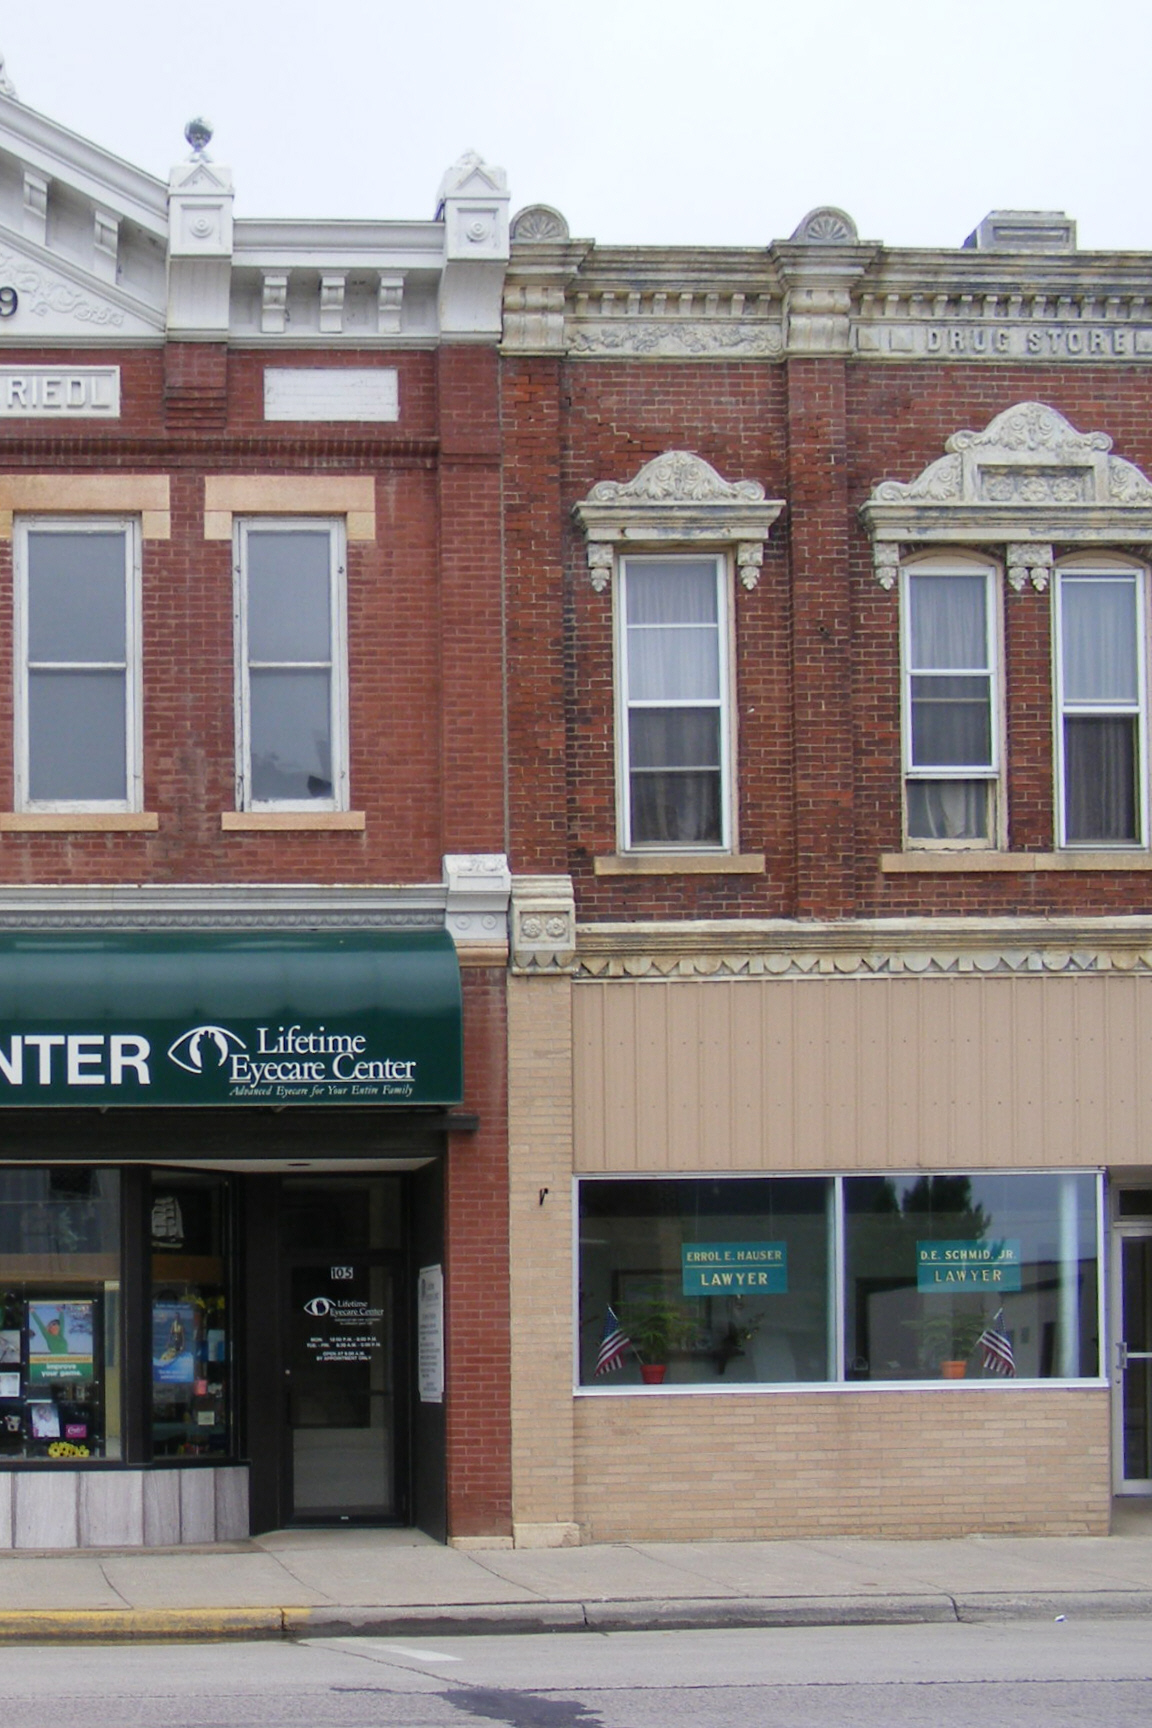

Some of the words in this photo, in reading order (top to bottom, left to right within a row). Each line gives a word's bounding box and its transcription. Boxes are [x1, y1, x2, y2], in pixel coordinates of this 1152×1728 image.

[927, 328, 1010, 353] DRUG
[1027, 328, 1126, 354] STORE
[7, 376, 110, 409] RIEDL
[257, 1026, 366, 1054] Lifetime
[230, 1054, 325, 1088] Eyecare
[332, 1053, 416, 1080] Center
[229, 1086, 273, 1096] Advanced
[276, 1086, 308, 1098] Eyecare
[309, 1085, 325, 1097] for
[328, 1085, 347, 1095] Your
[382, 1084, 413, 1097] Family
[686, 1251, 722, 1261] ERROL
[724, 1251, 735, 1260] E.
[737, 1250, 782, 1260] HAUSER
[332, 1267, 353, 1279] 105
[701, 1272, 768, 1286] LAWYER
[934, 1269, 1002, 1282] LAWYER
[337, 1300, 369, 1308] Lifetime
[330, 1308, 359, 1317] Eyecare
[359, 1308, 385, 1316] Center
